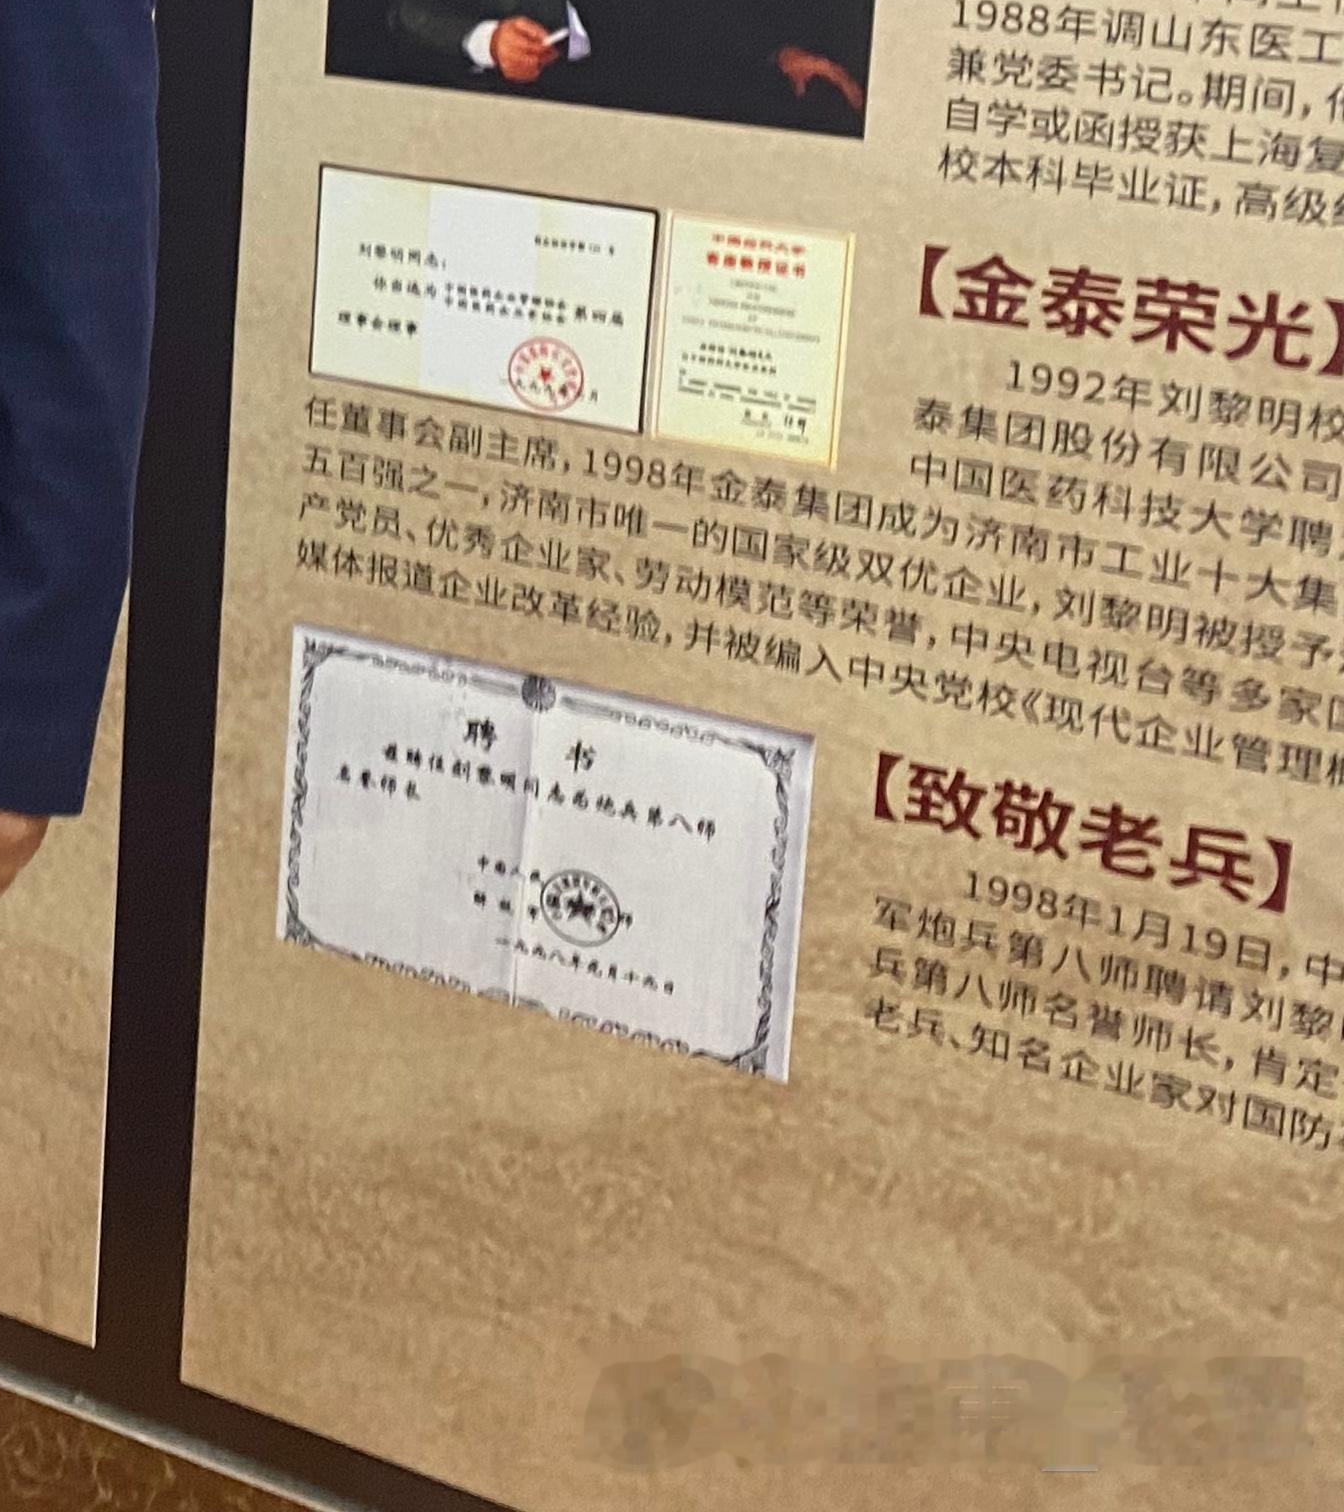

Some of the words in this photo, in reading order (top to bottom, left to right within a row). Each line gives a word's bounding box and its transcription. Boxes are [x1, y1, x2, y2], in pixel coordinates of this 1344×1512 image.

[938, 144, 1344, 228] 校本科毕业证，高级
[944, 95, 1344, 177] 自学或函授获上海复
[919, 244, 1344, 378] 【金泰荣光】
[913, 394, 1342, 502] 泰集团股份有限公司
[1006, 359, 1344, 446] 1992年刘黎明校
[301, 442, 1344, 675] 五百强之一，济南市唯一的国家级双优企业，刘黎明被授予
[909, 450, 1344, 559] 中国医药科技大学聘
[873, 750, 1294, 914] 【致敬老兵】
[869, 945, 1344, 1102] 兵第八师名誉师长，肯定
[874, 894, 1344, 1045] 军炮兵第八师聘请刘黎
[865, 996, 1344, 1153] 老兵、知名企业家对国防
